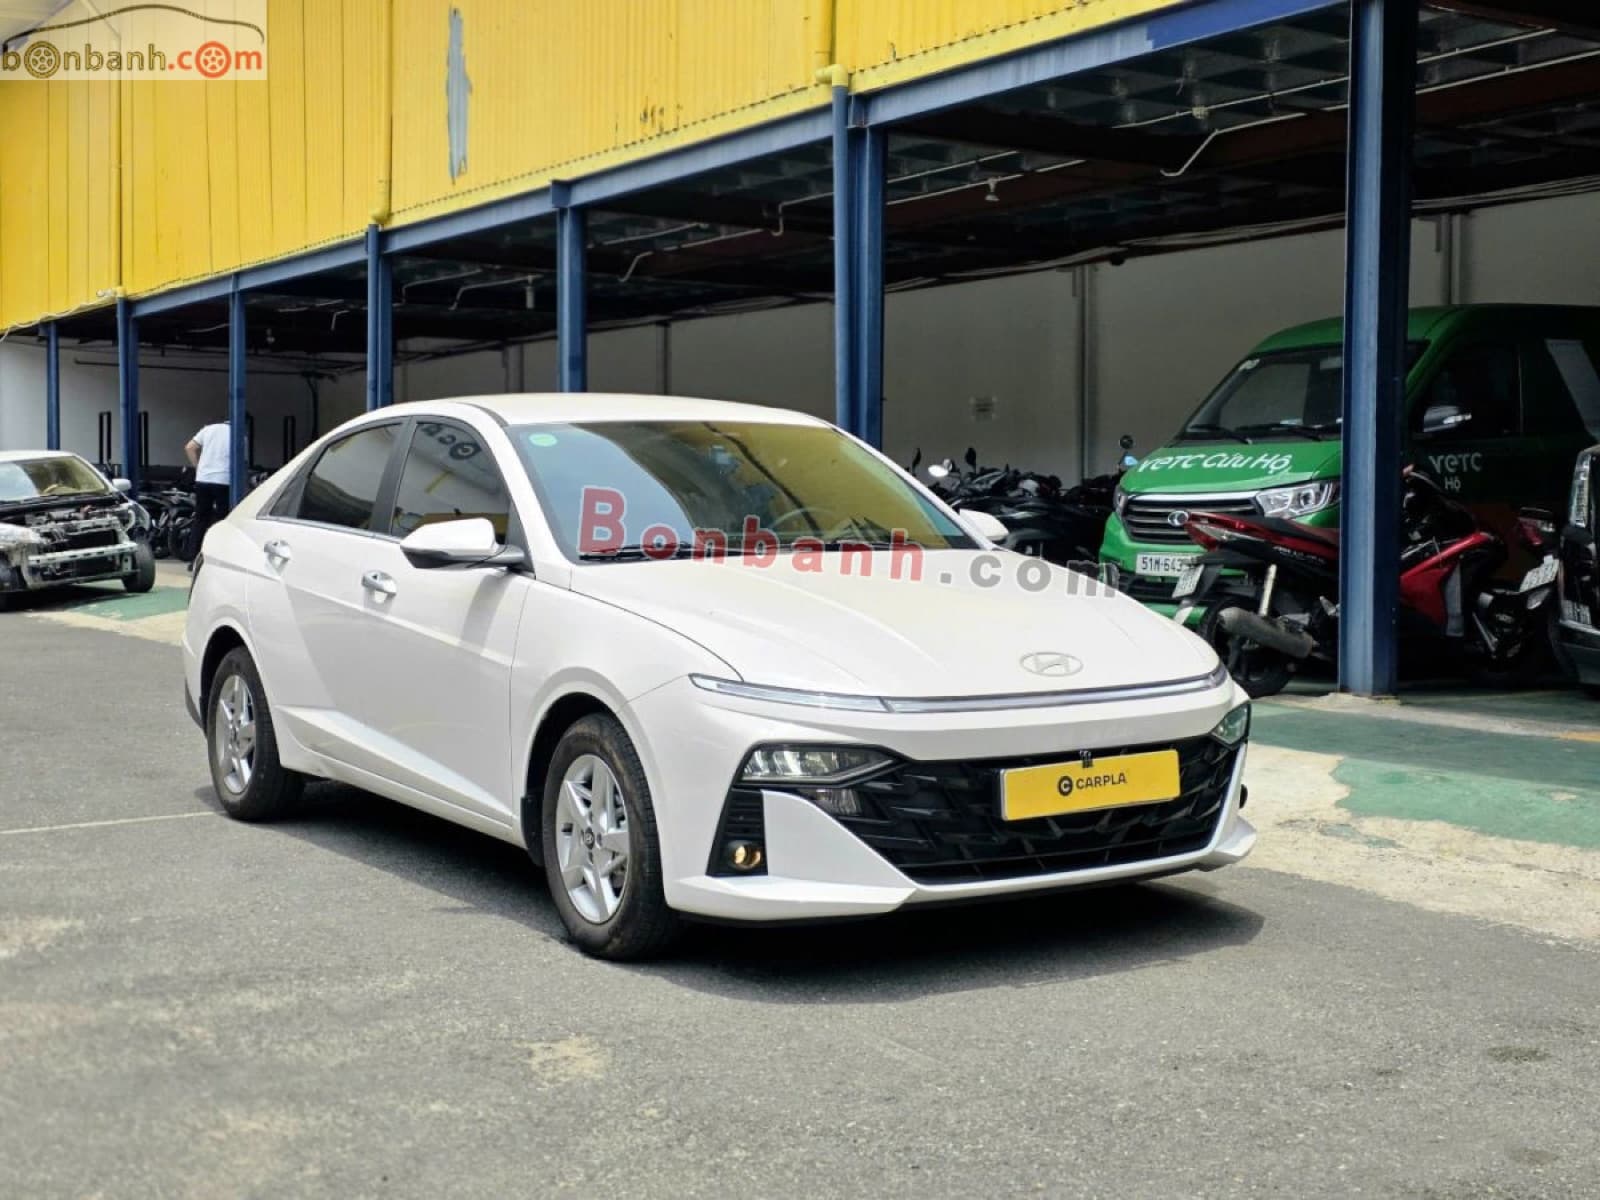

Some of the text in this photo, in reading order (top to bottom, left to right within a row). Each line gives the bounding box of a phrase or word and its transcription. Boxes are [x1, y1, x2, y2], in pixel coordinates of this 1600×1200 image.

[1250, 453, 1292, 474] Hộ
[1141, 556, 1186, 572] 51M-643
[1076, 773, 1126, 790] CARPLA
